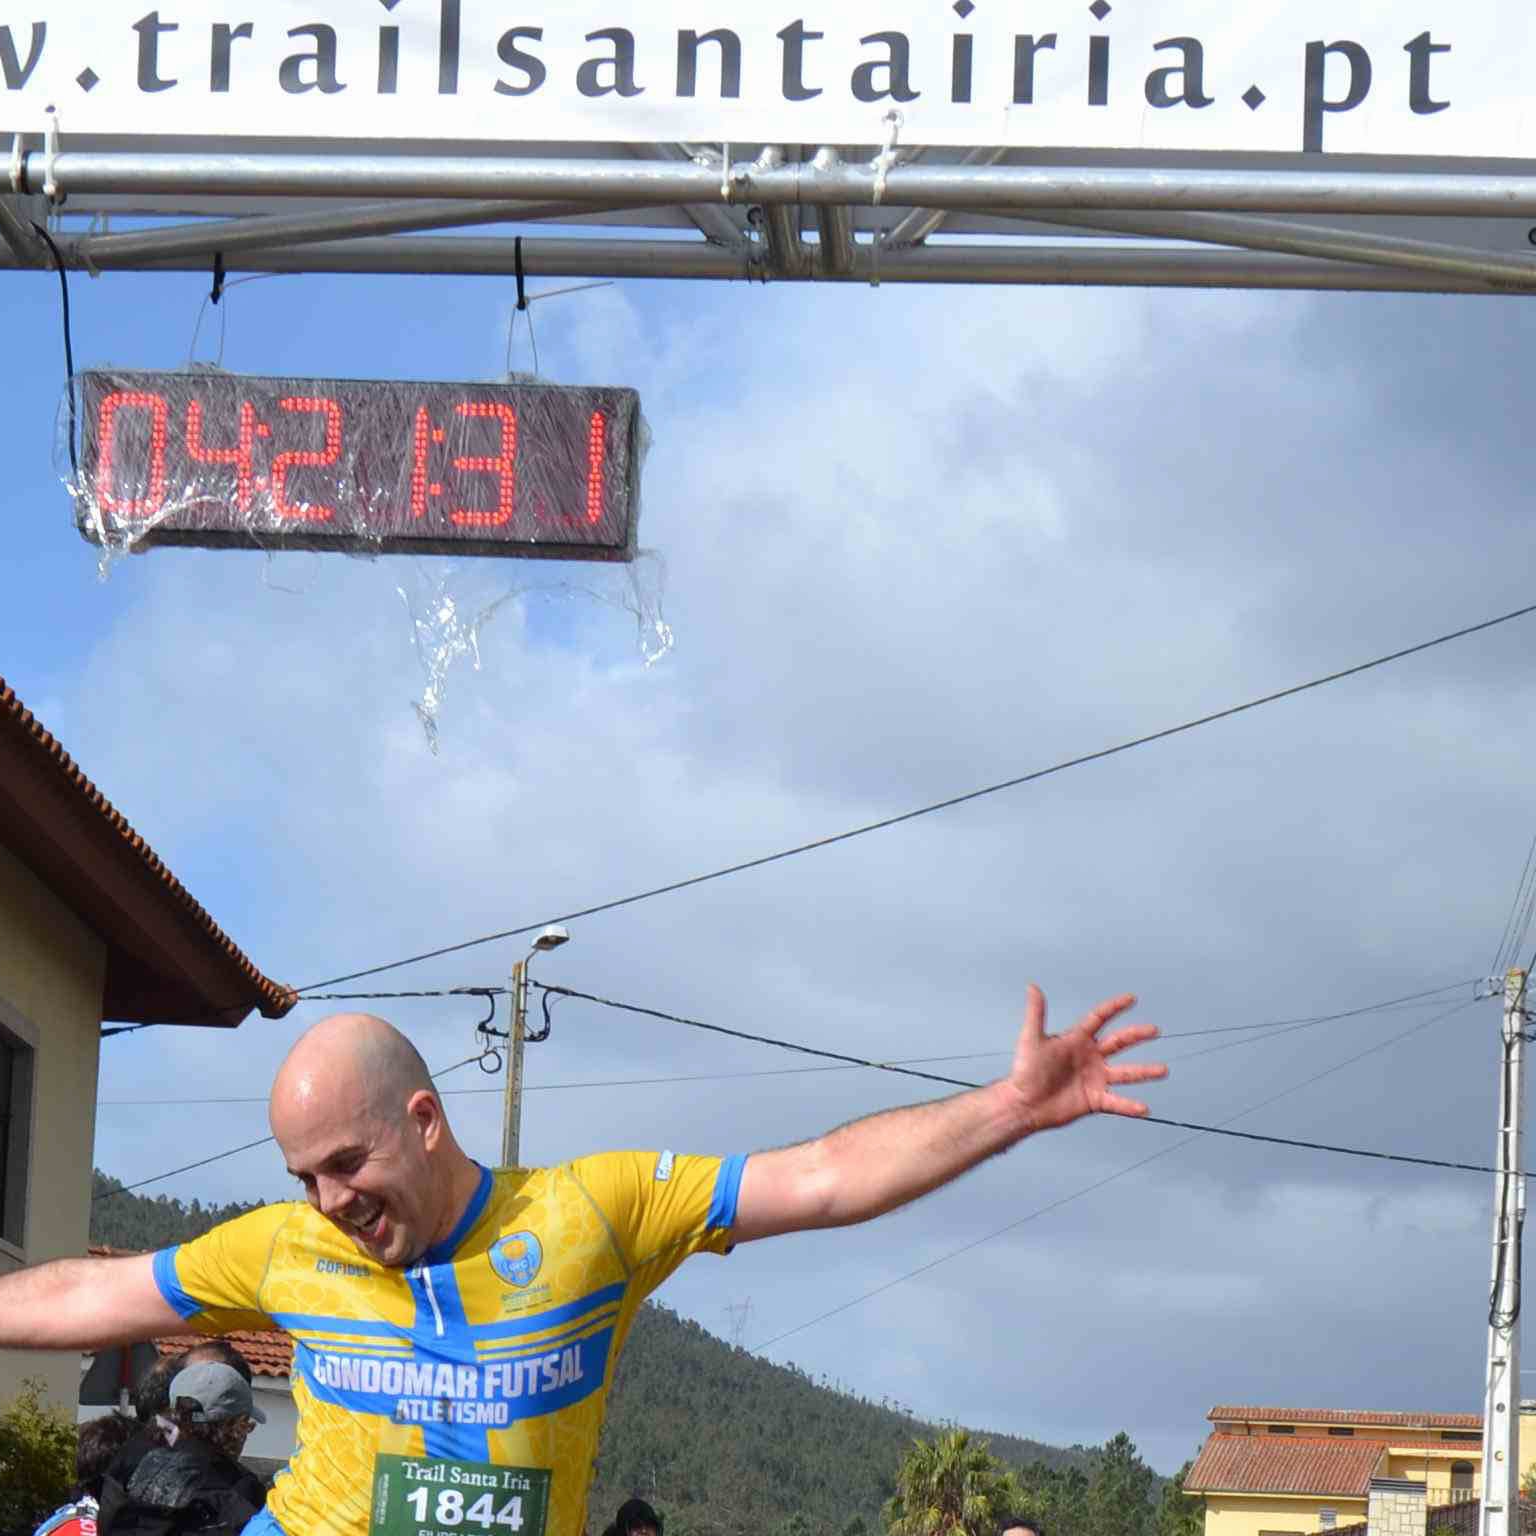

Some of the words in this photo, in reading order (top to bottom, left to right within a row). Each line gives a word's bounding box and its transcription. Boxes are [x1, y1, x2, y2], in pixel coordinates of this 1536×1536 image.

[483, 1344, 584, 1400] FUTSAL
[395, 1398, 509, 1426] ATLETISMO
[401, 1461, 445, 1483] Trail
[450, 1466, 499, 1488] Santa
[503, 1471, 531, 1491] Iria
[406, 1485, 524, 1532] 1844
